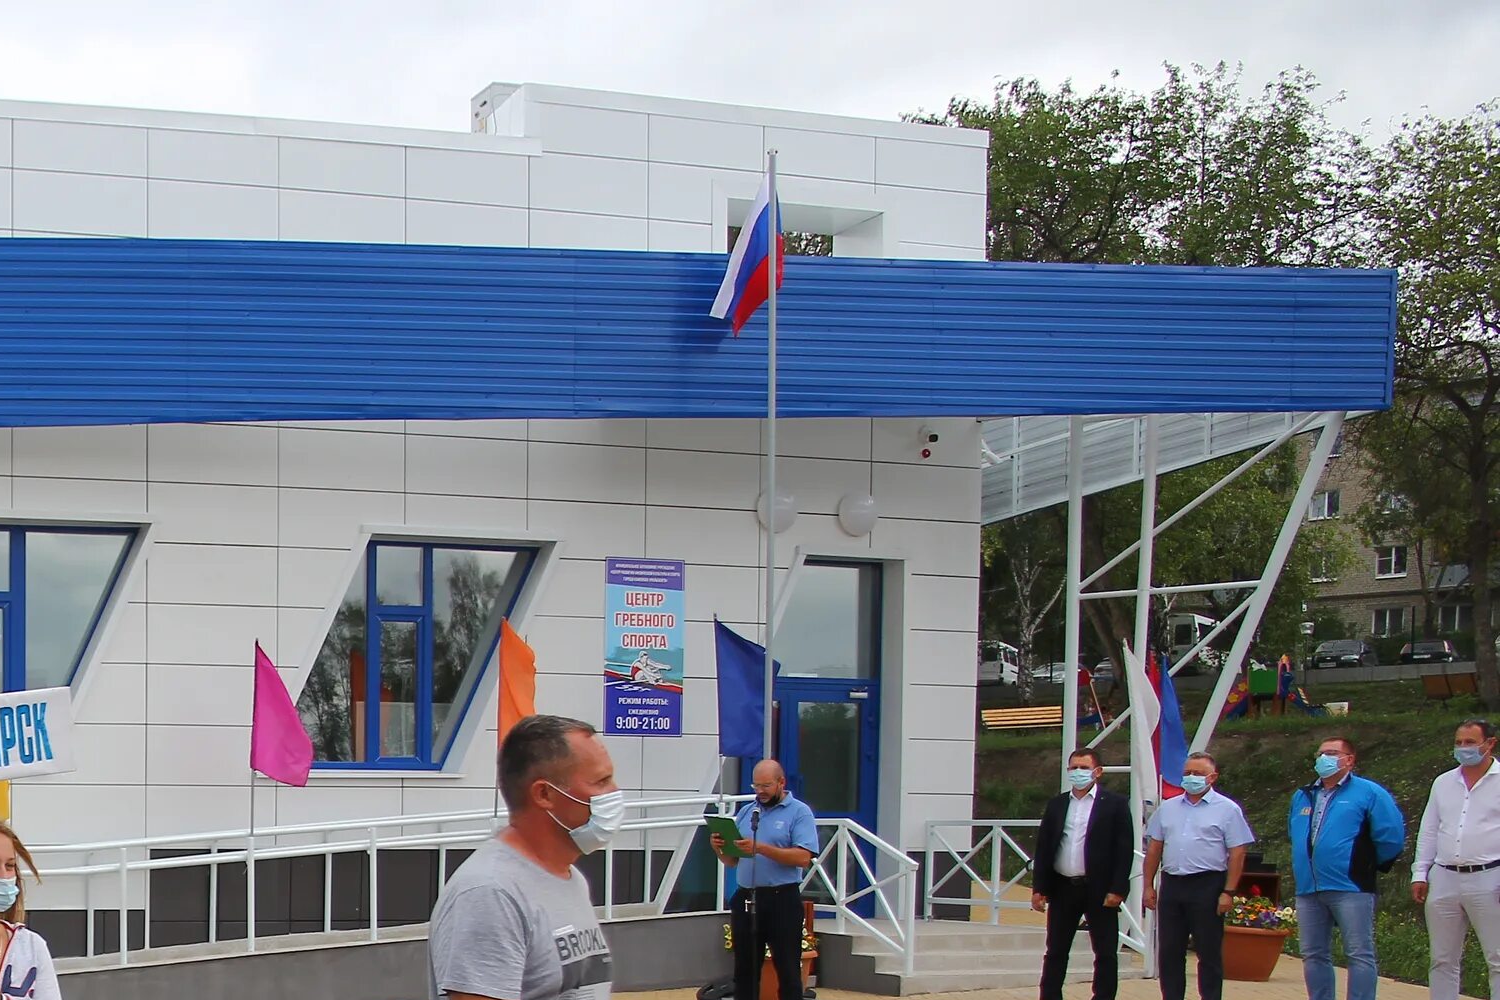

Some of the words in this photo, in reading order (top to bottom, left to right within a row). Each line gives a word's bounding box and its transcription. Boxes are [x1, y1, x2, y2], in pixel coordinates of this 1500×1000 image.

[626, 593, 663, 607] ЦЕНТР
[616, 613, 674, 627] ГРЕБНОГО
[622, 634, 667, 649] СПОРТА
[618, 697, 641, 705] РЕЖИМ
[642, 697, 669, 706] РАБОТЫ:
[615, 716, 671, 730] 9:00-21:00
